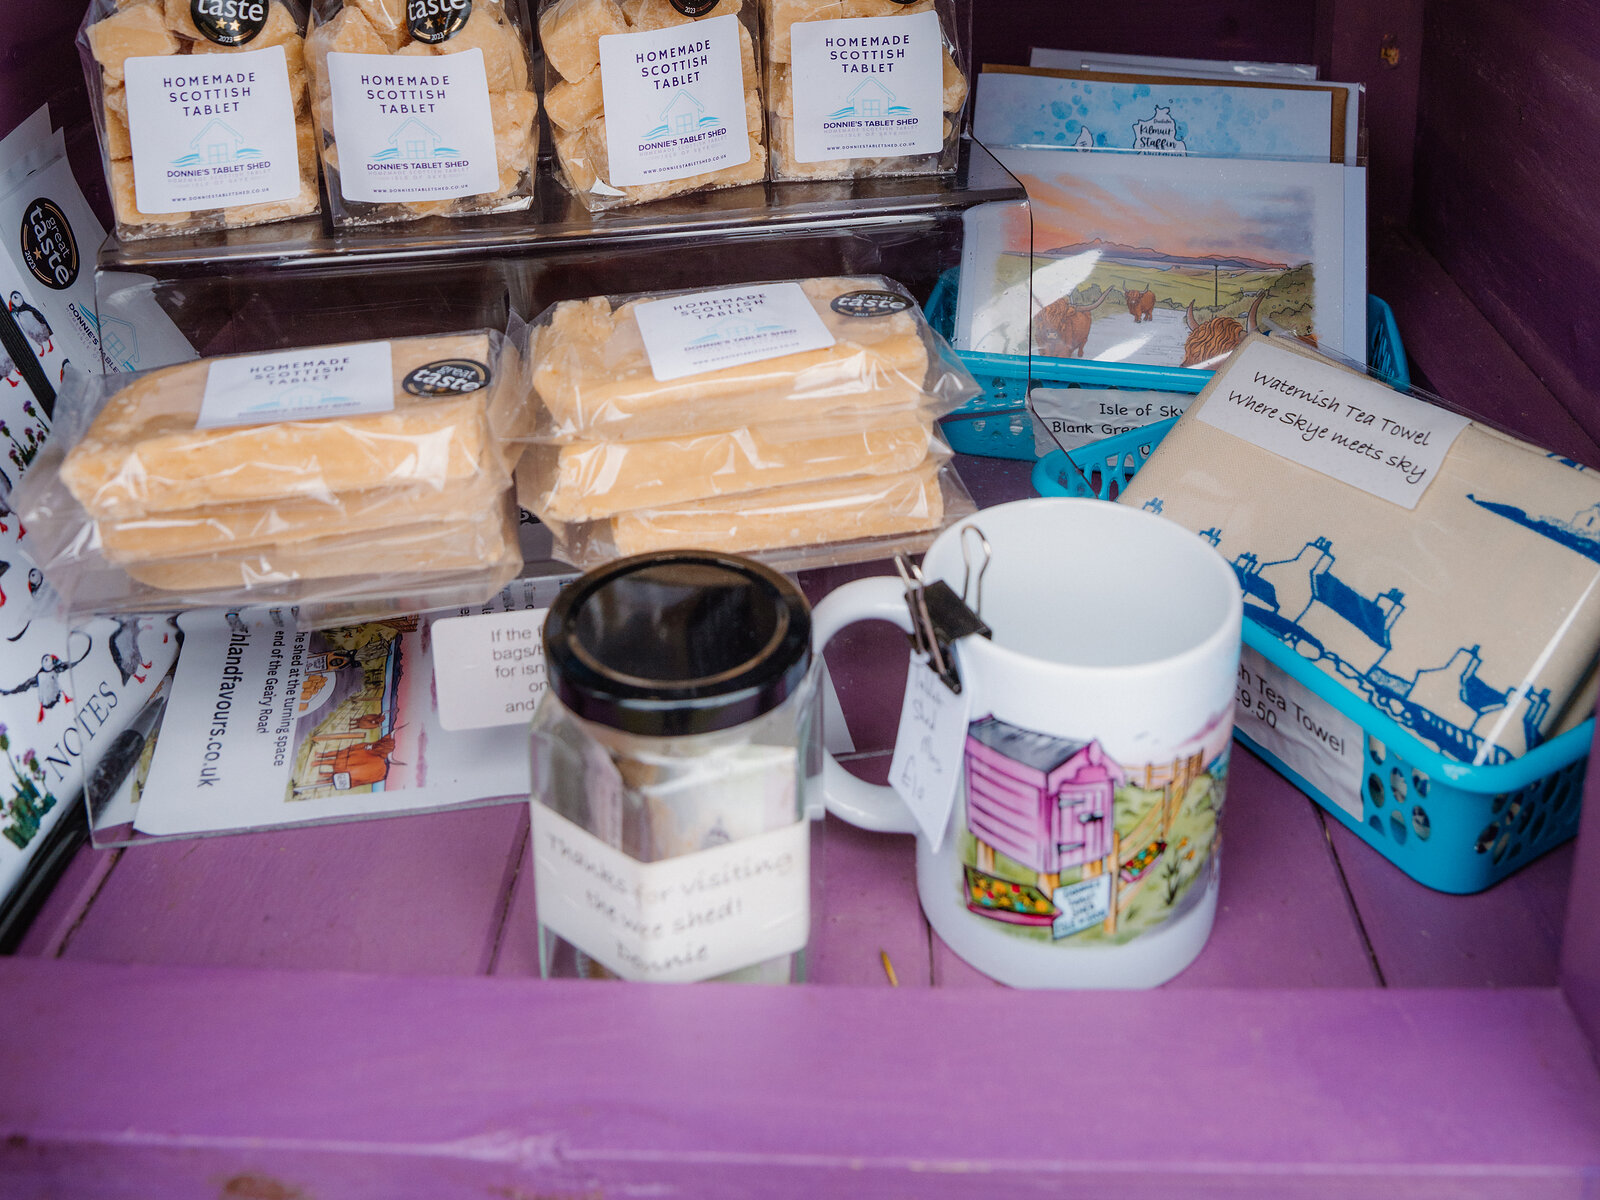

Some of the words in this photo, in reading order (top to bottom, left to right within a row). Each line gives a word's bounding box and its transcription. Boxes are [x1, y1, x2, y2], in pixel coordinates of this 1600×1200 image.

[684, 5, 696, 14] 2023
[218, 34, 234, 44] 2023
[430, 32, 444, 42] 2023
[825, 34, 911, 48] HOMEMADE
[636, 39, 712, 64] HOMEMADE
[830, 48, 906, 61] SCOTTISH
[641, 55, 709, 78] SCOTTISH
[842, 62, 895, 74] TABLET
[163, 72, 257, 88] HOMEMADE
[361, 74, 450, 87] HOMEMADE
[653, 71, 701, 90] TABLET
[169, 87, 252, 103] SCOTTISH
[366, 89, 447, 100] SCOTTISH
[182, 101, 240, 117] TABLET
[380, 103, 436, 114] TABLET
[823, 119, 864, 129] DONNIE'S
[864, 118, 895, 127] TABLET
[896, 117, 919, 126] SHED
[1140, 125, 1174, 136] Kilmuir
[638, 138, 678, 152] DONNIE'S
[679, 132, 706, 145] TABLET
[707, 127, 727, 139] SHED
[1140, 137, 1177, 150] Staffin
[166, 167, 210, 178] DONNIE'S
[212, 164, 245, 175] TABLET
[247, 161, 271, 171] SHED
[366, 162, 409, 171] DONNIE'S
[410, 161, 443, 170] TABLET
[445, 160, 469, 168] SHED
[29, 204, 71, 286] taste
[48, 216, 71, 259] great
[673, 292, 767, 312] HOMEMADE
[837, 296, 906, 310] taste
[855, 292, 895, 301] great
[680, 299, 765, 318] SCOTTISH
[695, 307, 755, 321] TABLET
[67, 302, 99, 346] DONNIE'S
[98, 345, 121, 375] TABLE
[250, 357, 351, 374] HOMEMADE
[254, 366, 345, 381] SCOTTISH
[439, 365, 477, 380] great
[268, 374, 331, 386] TABLET
[412, 367, 481, 393] taste
[1099, 403, 1129, 416] Isle
[1135, 403, 1153, 417] of
[1253, 371, 1342, 413] Waternish
[1346, 404, 1375, 427] Tea
[1382, 417, 1431, 447] Towel
[1052, 421, 1094, 435] Blank
[1228, 390, 1279, 420] Where
[1279, 412, 1329, 442] Skye
[1331, 433, 1385, 461] meets
[1385, 456, 1427, 485] sky
[272, 630, 285, 647] end
[491, 630, 501, 643] If
[506, 627, 532, 641] the
[270, 648, 284, 659] of
[290, 644, 307, 667] shed
[492, 643, 545, 661] bags/b
[267, 660, 282, 676] the
[288, 668, 302, 678] at
[494, 665, 516, 679] for
[258, 677, 279, 706] Geary
[284, 679, 300, 696] the
[197, 630, 252, 788] hlandfavours.co.uk
[505, 698, 536, 714] and
[256, 708, 273, 734] Road
[274, 696, 295, 734] turning
[1255, 673, 1287, 712] Tea
[1291, 701, 1345, 756] Towel
[45, 680, 119, 783] NOTES
[273, 735, 289, 767] space
[545, 832, 628, 894] Thanks
[680, 848, 796, 893] visiting
